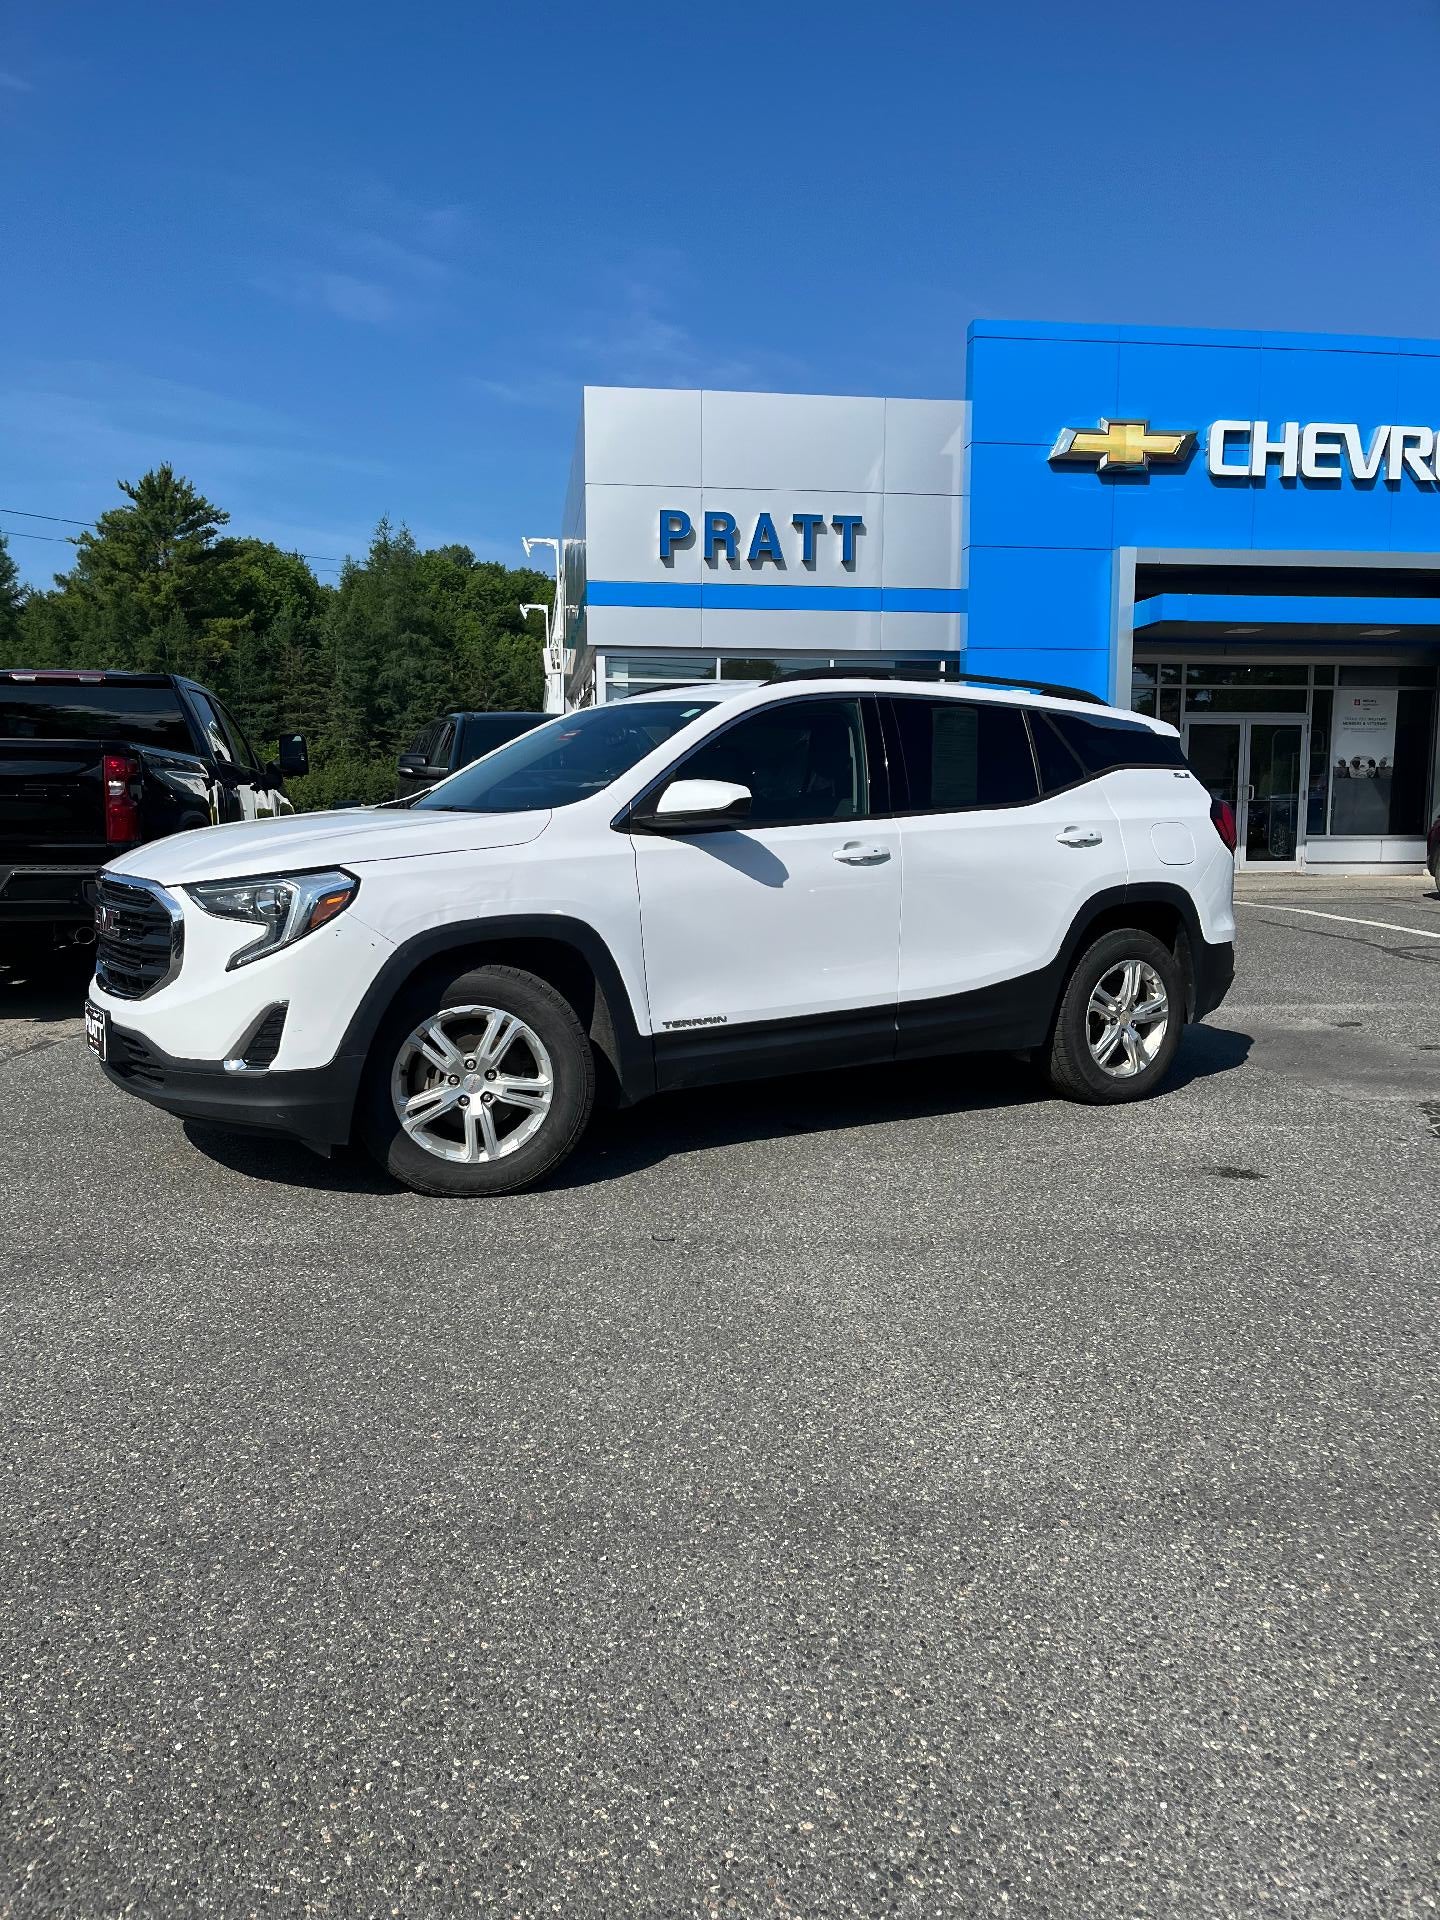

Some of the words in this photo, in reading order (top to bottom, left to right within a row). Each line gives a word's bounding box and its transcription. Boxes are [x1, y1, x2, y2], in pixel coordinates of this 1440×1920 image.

[1208, 420, 1440, 481] CHEVR
[659, 509, 863, 562] PRATT
[662, 1015, 728, 1030] TERRAIN
